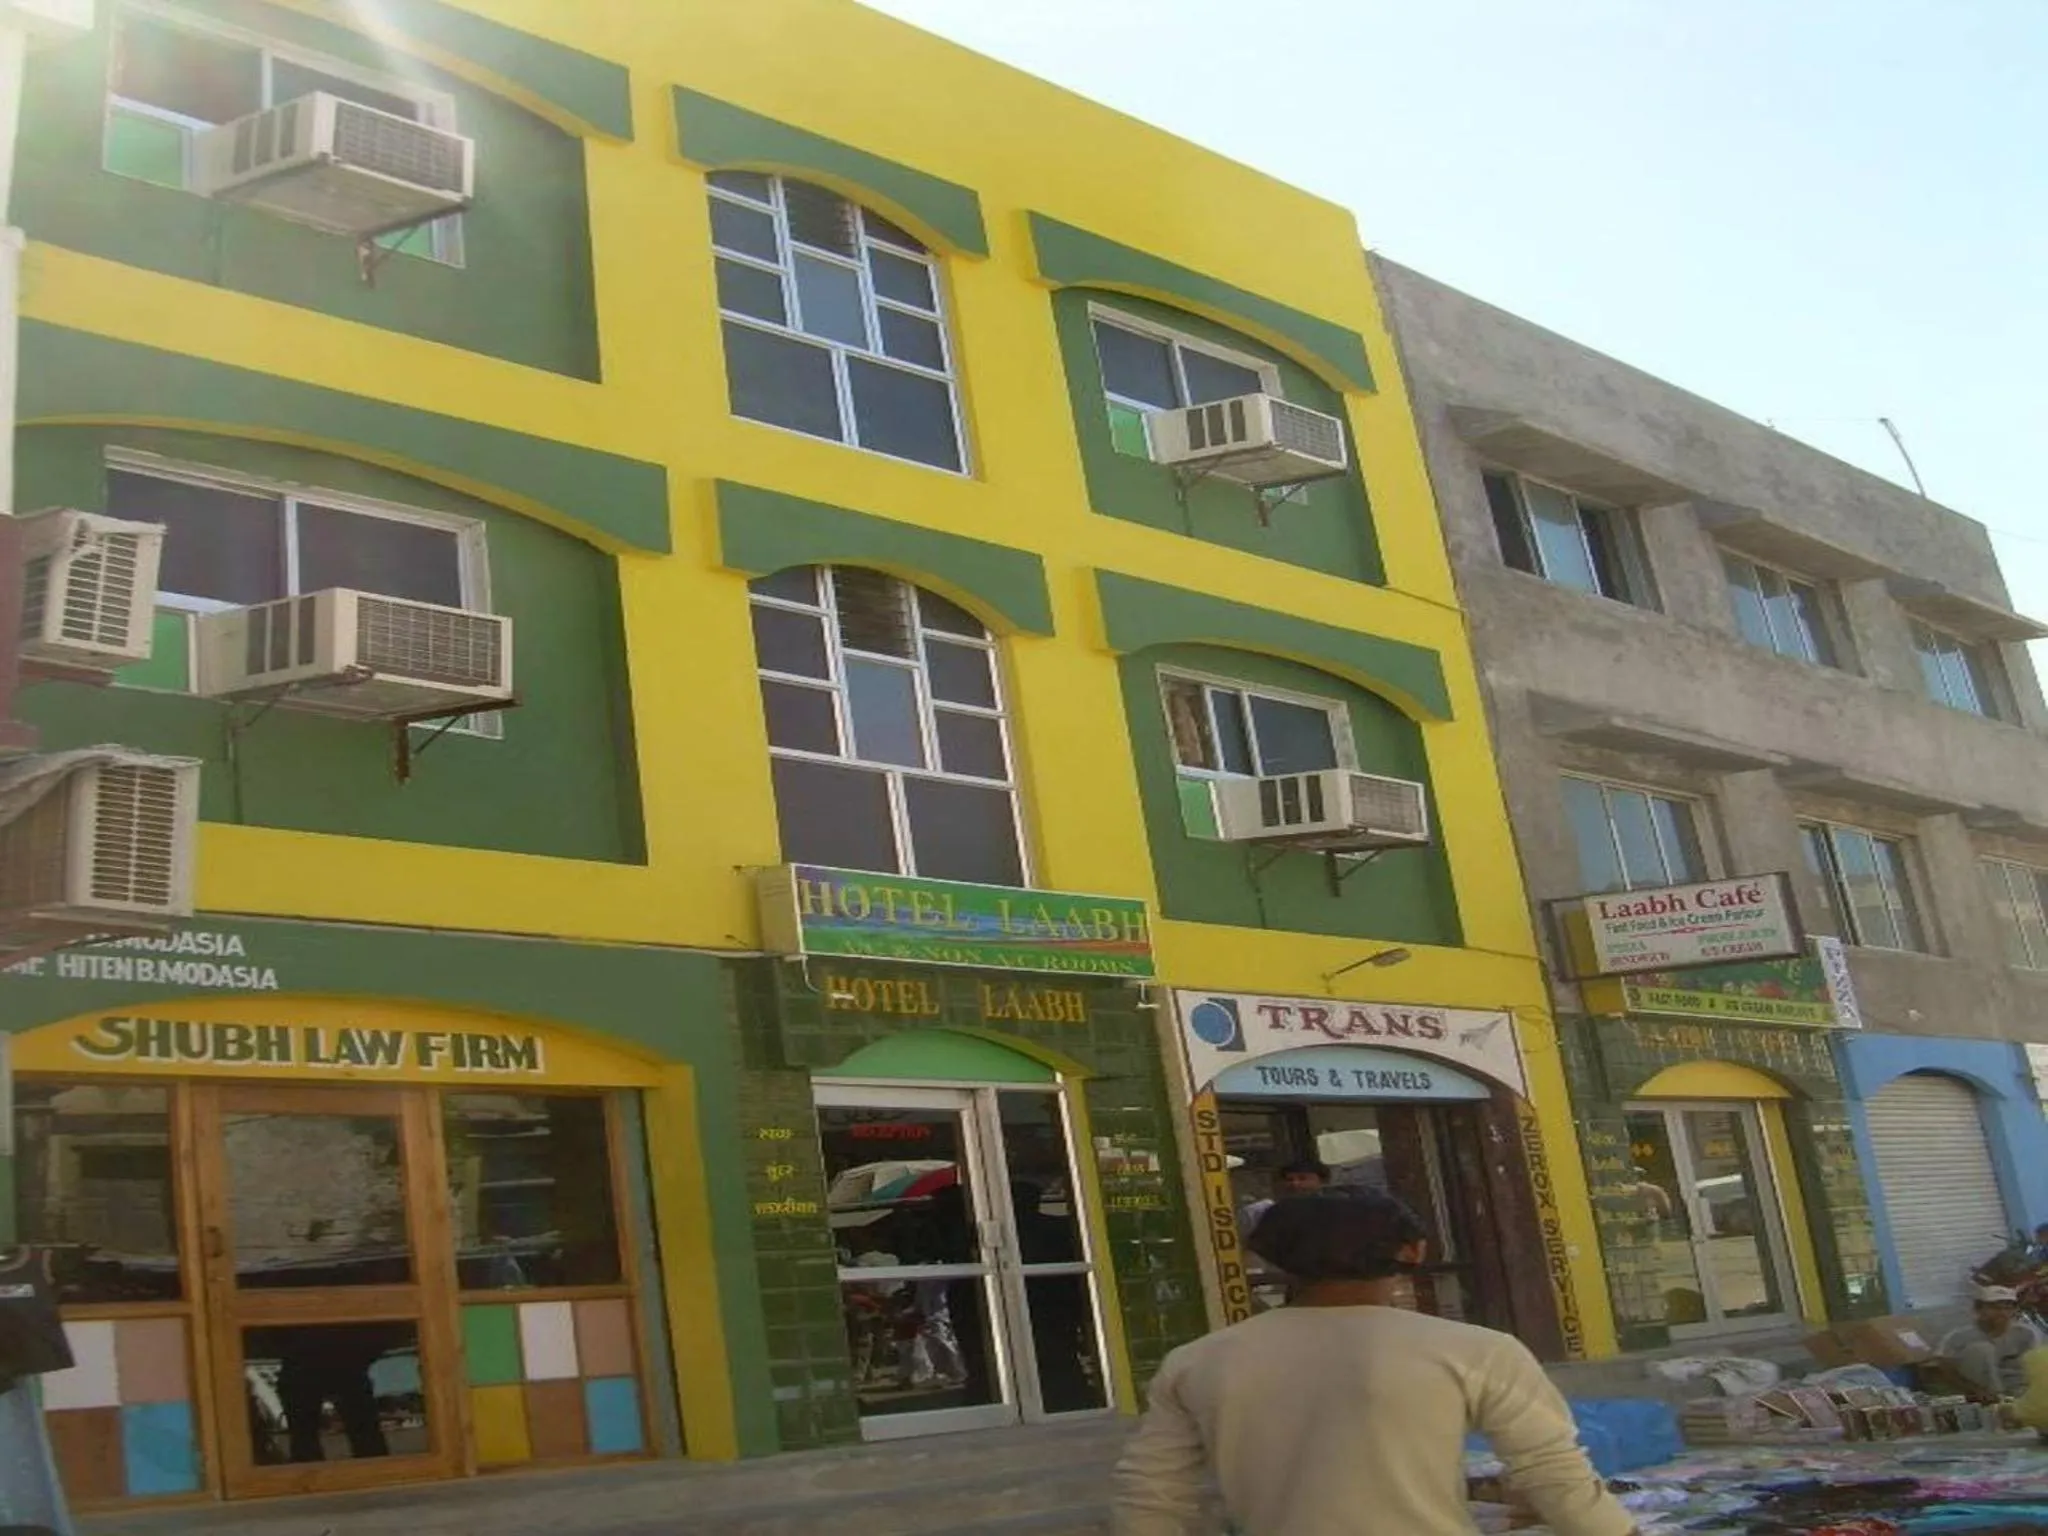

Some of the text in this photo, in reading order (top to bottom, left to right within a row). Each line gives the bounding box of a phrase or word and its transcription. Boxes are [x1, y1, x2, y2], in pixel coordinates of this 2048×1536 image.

[800, 878, 1148, 944] HOTEL LAABH
[1598, 893, 1686, 920] Laabh
[57, 952, 132, 981] HITEN
[1043, 953, 1135, 974] ROOMS
[825, 975, 1087, 1023] HOTEL LAABH
[1257, 1003, 1447, 1041] TRANS
[72, 1016, 544, 1074] SHUBH LAW FIRM
[1256, 1064, 1433, 1091] TOURS & TRAVELS
[1195, 1109, 1223, 1173] STD
[1212, 1184, 1238, 1252] ISD
[1543, 1216, 1584, 1353] SERVICE
